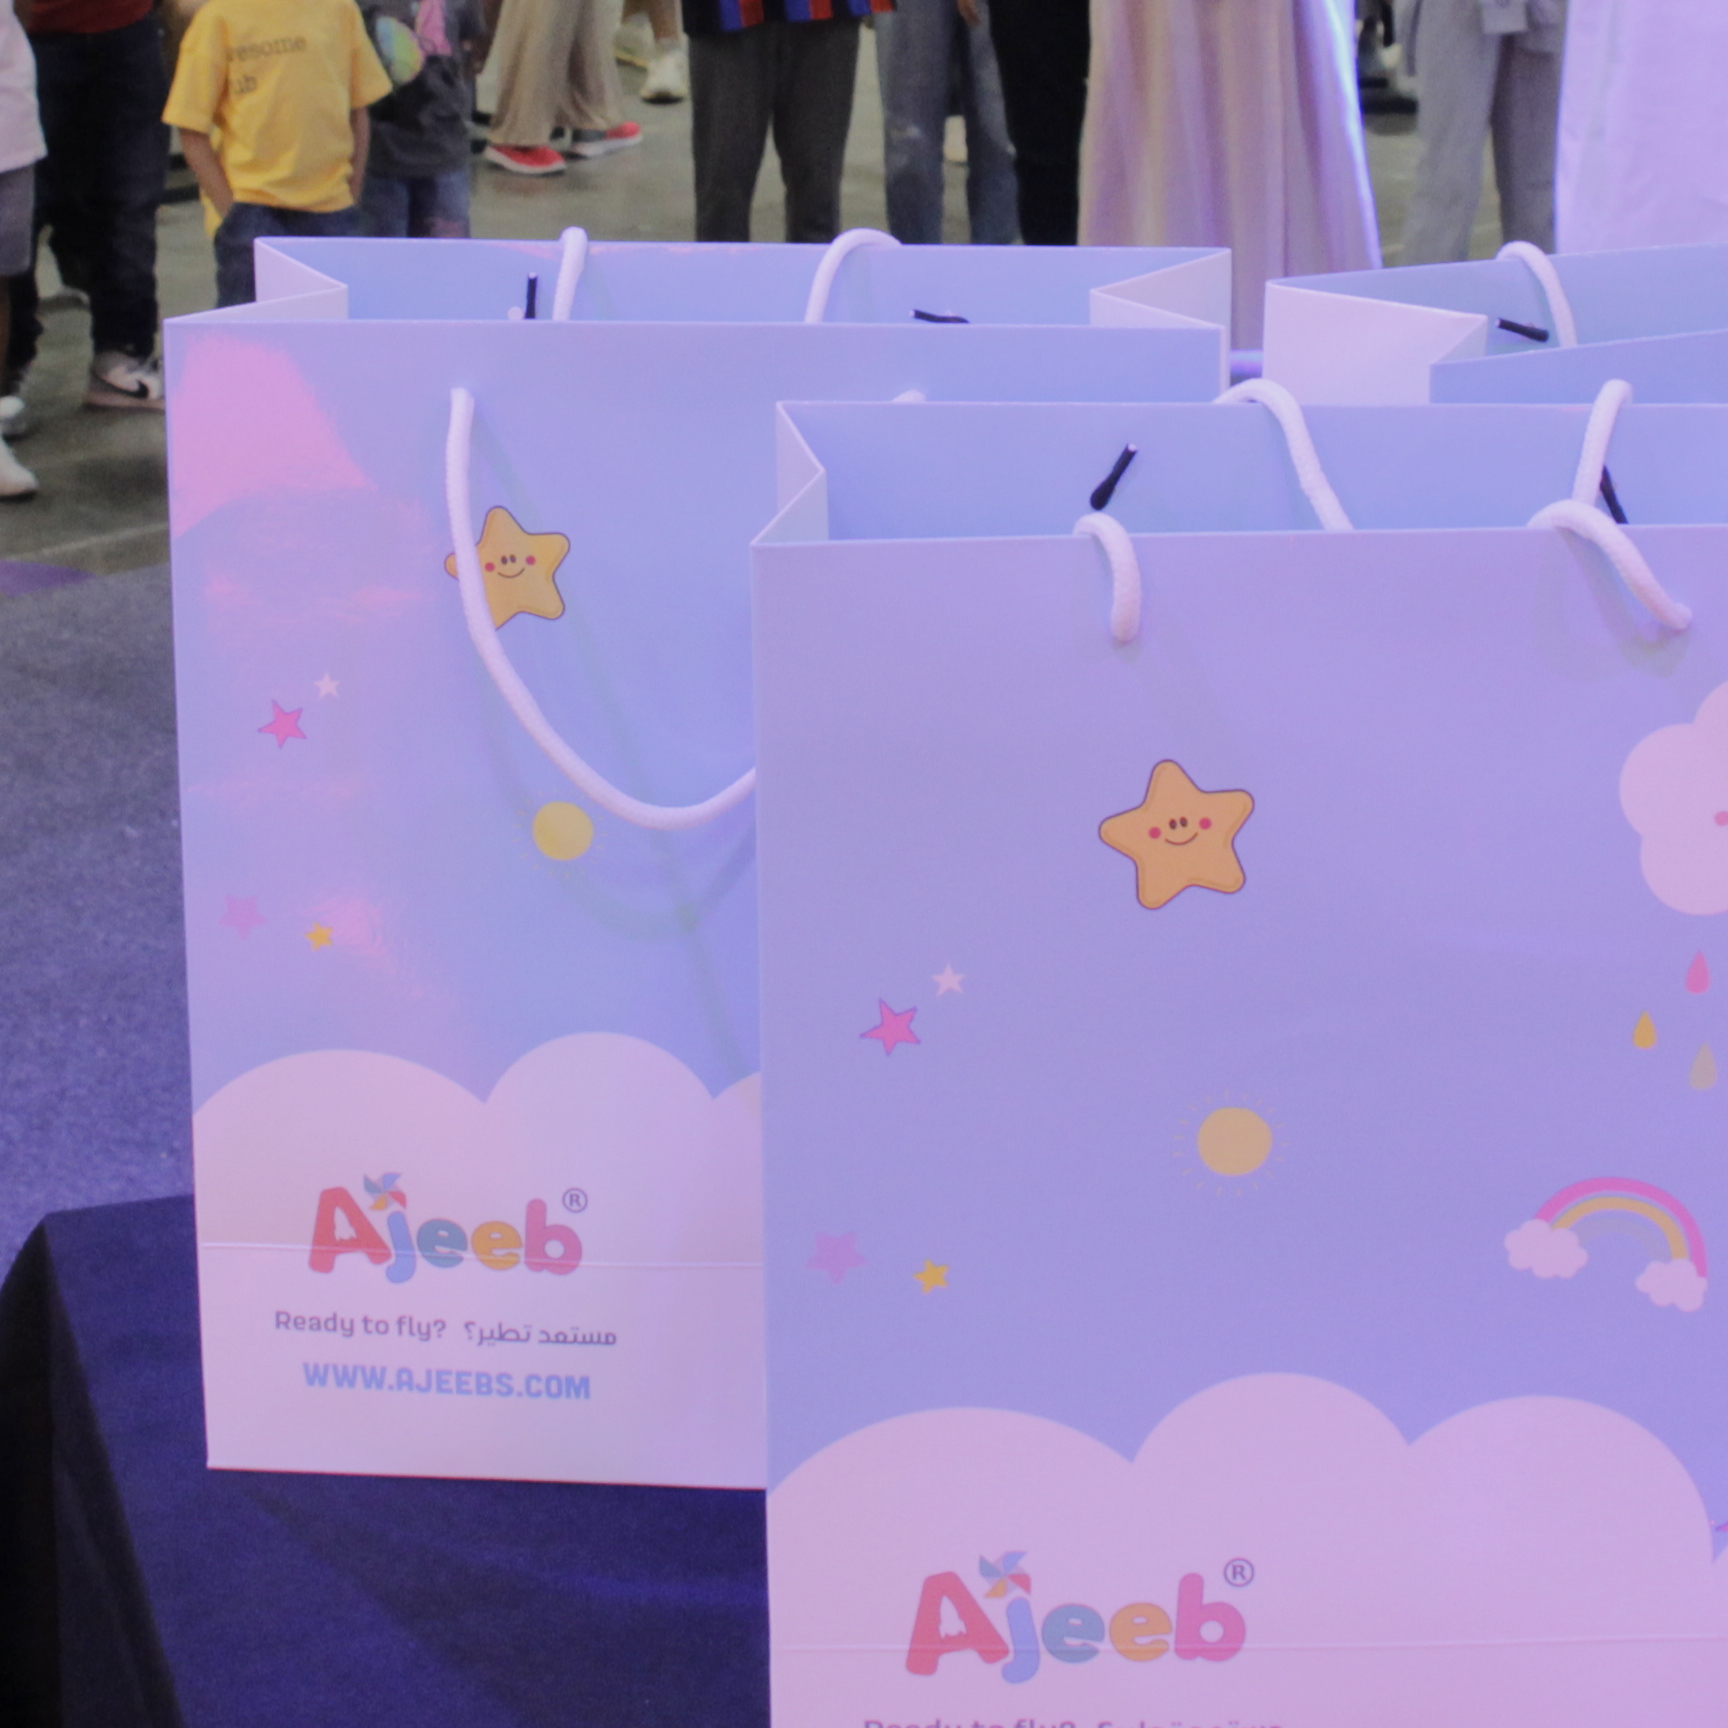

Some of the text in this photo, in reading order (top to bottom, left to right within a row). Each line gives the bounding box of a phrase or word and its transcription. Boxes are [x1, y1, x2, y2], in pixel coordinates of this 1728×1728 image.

[274, 1310, 447, 1342] Ready to fly?
[463, 1321, 618, 1347] مستعد تطير؟
[302, 1361, 591, 1400] WWW.AJEEBS.COM
